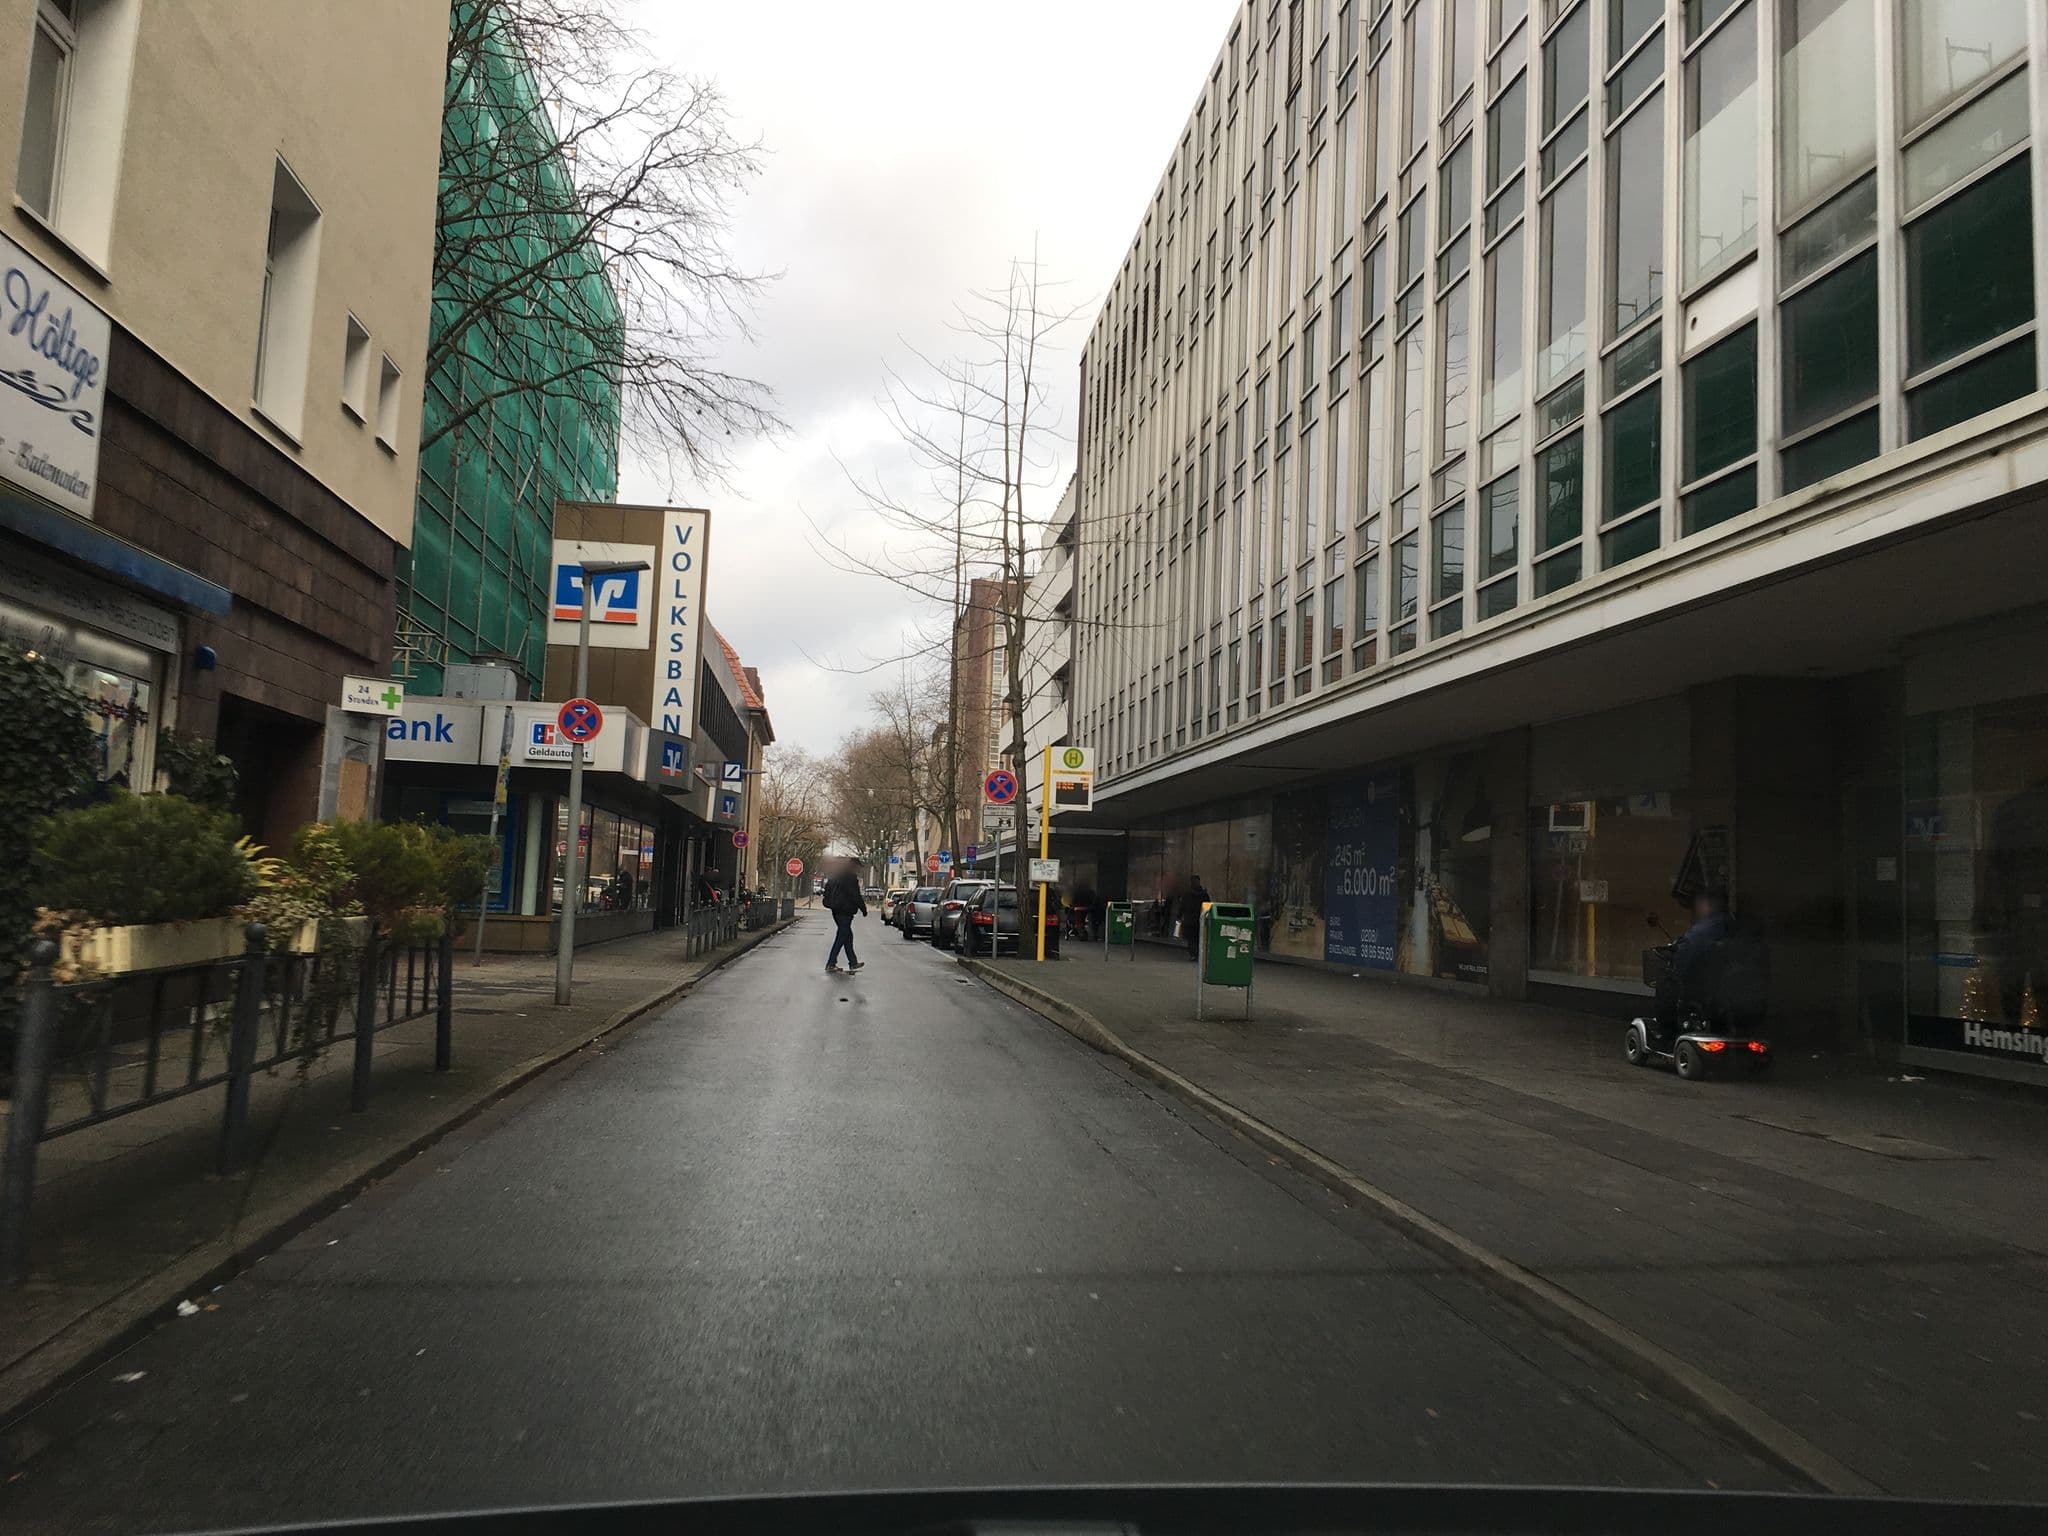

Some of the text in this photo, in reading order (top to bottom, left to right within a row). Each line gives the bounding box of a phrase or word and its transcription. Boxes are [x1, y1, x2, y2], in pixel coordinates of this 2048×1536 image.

[5, 268, 99, 400] Höltge
[662, 524, 693, 735] VOLKSBAN
[358, 685, 370, 694] 24
[387, 713, 454, 743] ank
[528, 747, 589, 758] Geldautot
[1335, 844, 1351, 866] 245
[1344, 868, 1376, 896] 6.000
